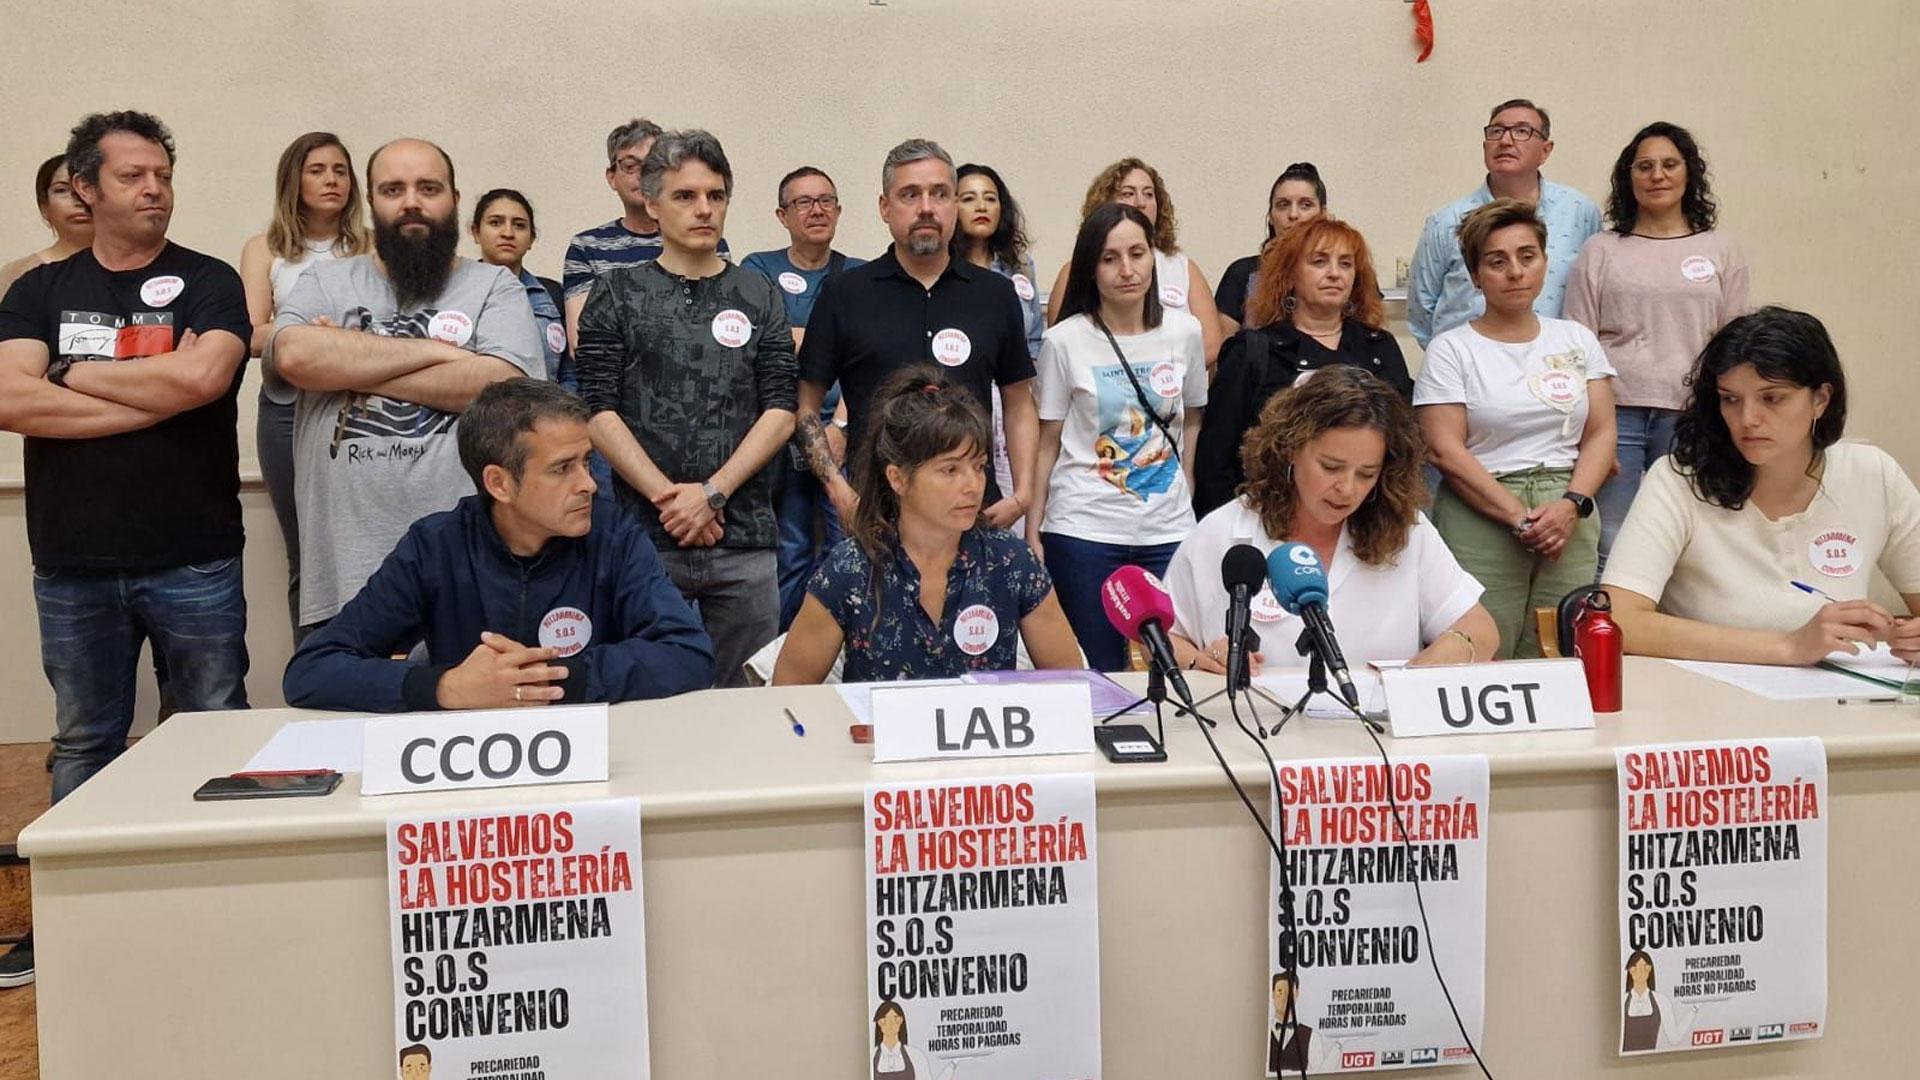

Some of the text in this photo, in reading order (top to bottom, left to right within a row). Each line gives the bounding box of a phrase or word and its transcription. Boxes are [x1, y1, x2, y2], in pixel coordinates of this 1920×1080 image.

[68, 312, 166, 328] TOMMY
[1437, 683, 1540, 729] UGT
[935, 706, 1035, 751] LAB
[400, 730, 572, 784] CCOO
[1625, 746, 1771, 792] SALVEMOS
[873, 782, 1034, 831] SALVEMOS
[1279, 763, 1432, 806] SALVEMOS
[1627, 777, 1820, 831] LA HOSTELERÍA
[396, 811, 574, 866] SALVEMOS
[1282, 797, 1480, 847] LA HOSTELERÍA
[874, 815, 1088, 874] LA HOSTELERÍA
[1281, 843, 1459, 887] HITZARMENA
[1628, 824, 1801, 871] HITZARMENA
[399, 844, 633, 910] LA HOSTELERÍA
[876, 866, 1068, 916] HITZARMENA
[1627, 871, 1697, 910] S.O.S
[401, 896, 611, 954] HITZARMENA
[876, 915, 954, 959] S.O.S
[1627, 905, 1764, 950] CONVENIO
[403, 951, 488, 997] S.O.S
[877, 952, 1028, 1001] CONVENIO
[1681, 969, 1745, 985] TEMPORALIDAD
[1685, 954, 1741, 970] PRECARIEDAD
[1327, 1000, 1395, 1016] TEMPORALIDAD
[1331, 987, 1391, 1002] PRECARIEDAD
[1673, 979, 1757, 998] HORAS NO PAGADAS
[405, 987, 570, 1043] CONVENIO
[936, 1020, 1008, 1038] TEMPORALIDAD
[940, 1004, 1004, 1022] PRECARIEDAD
[1319, 1013, 1407, 1030] HORAS NO PAGADAS
[928, 1032, 1021, 1052] HORAS NO PAGADAS
[1693, 1031, 1723, 1045] UGT
[470, 1055, 540, 1074] PRECARIEDAD
[1342, 1053, 1375, 1068] UGT
